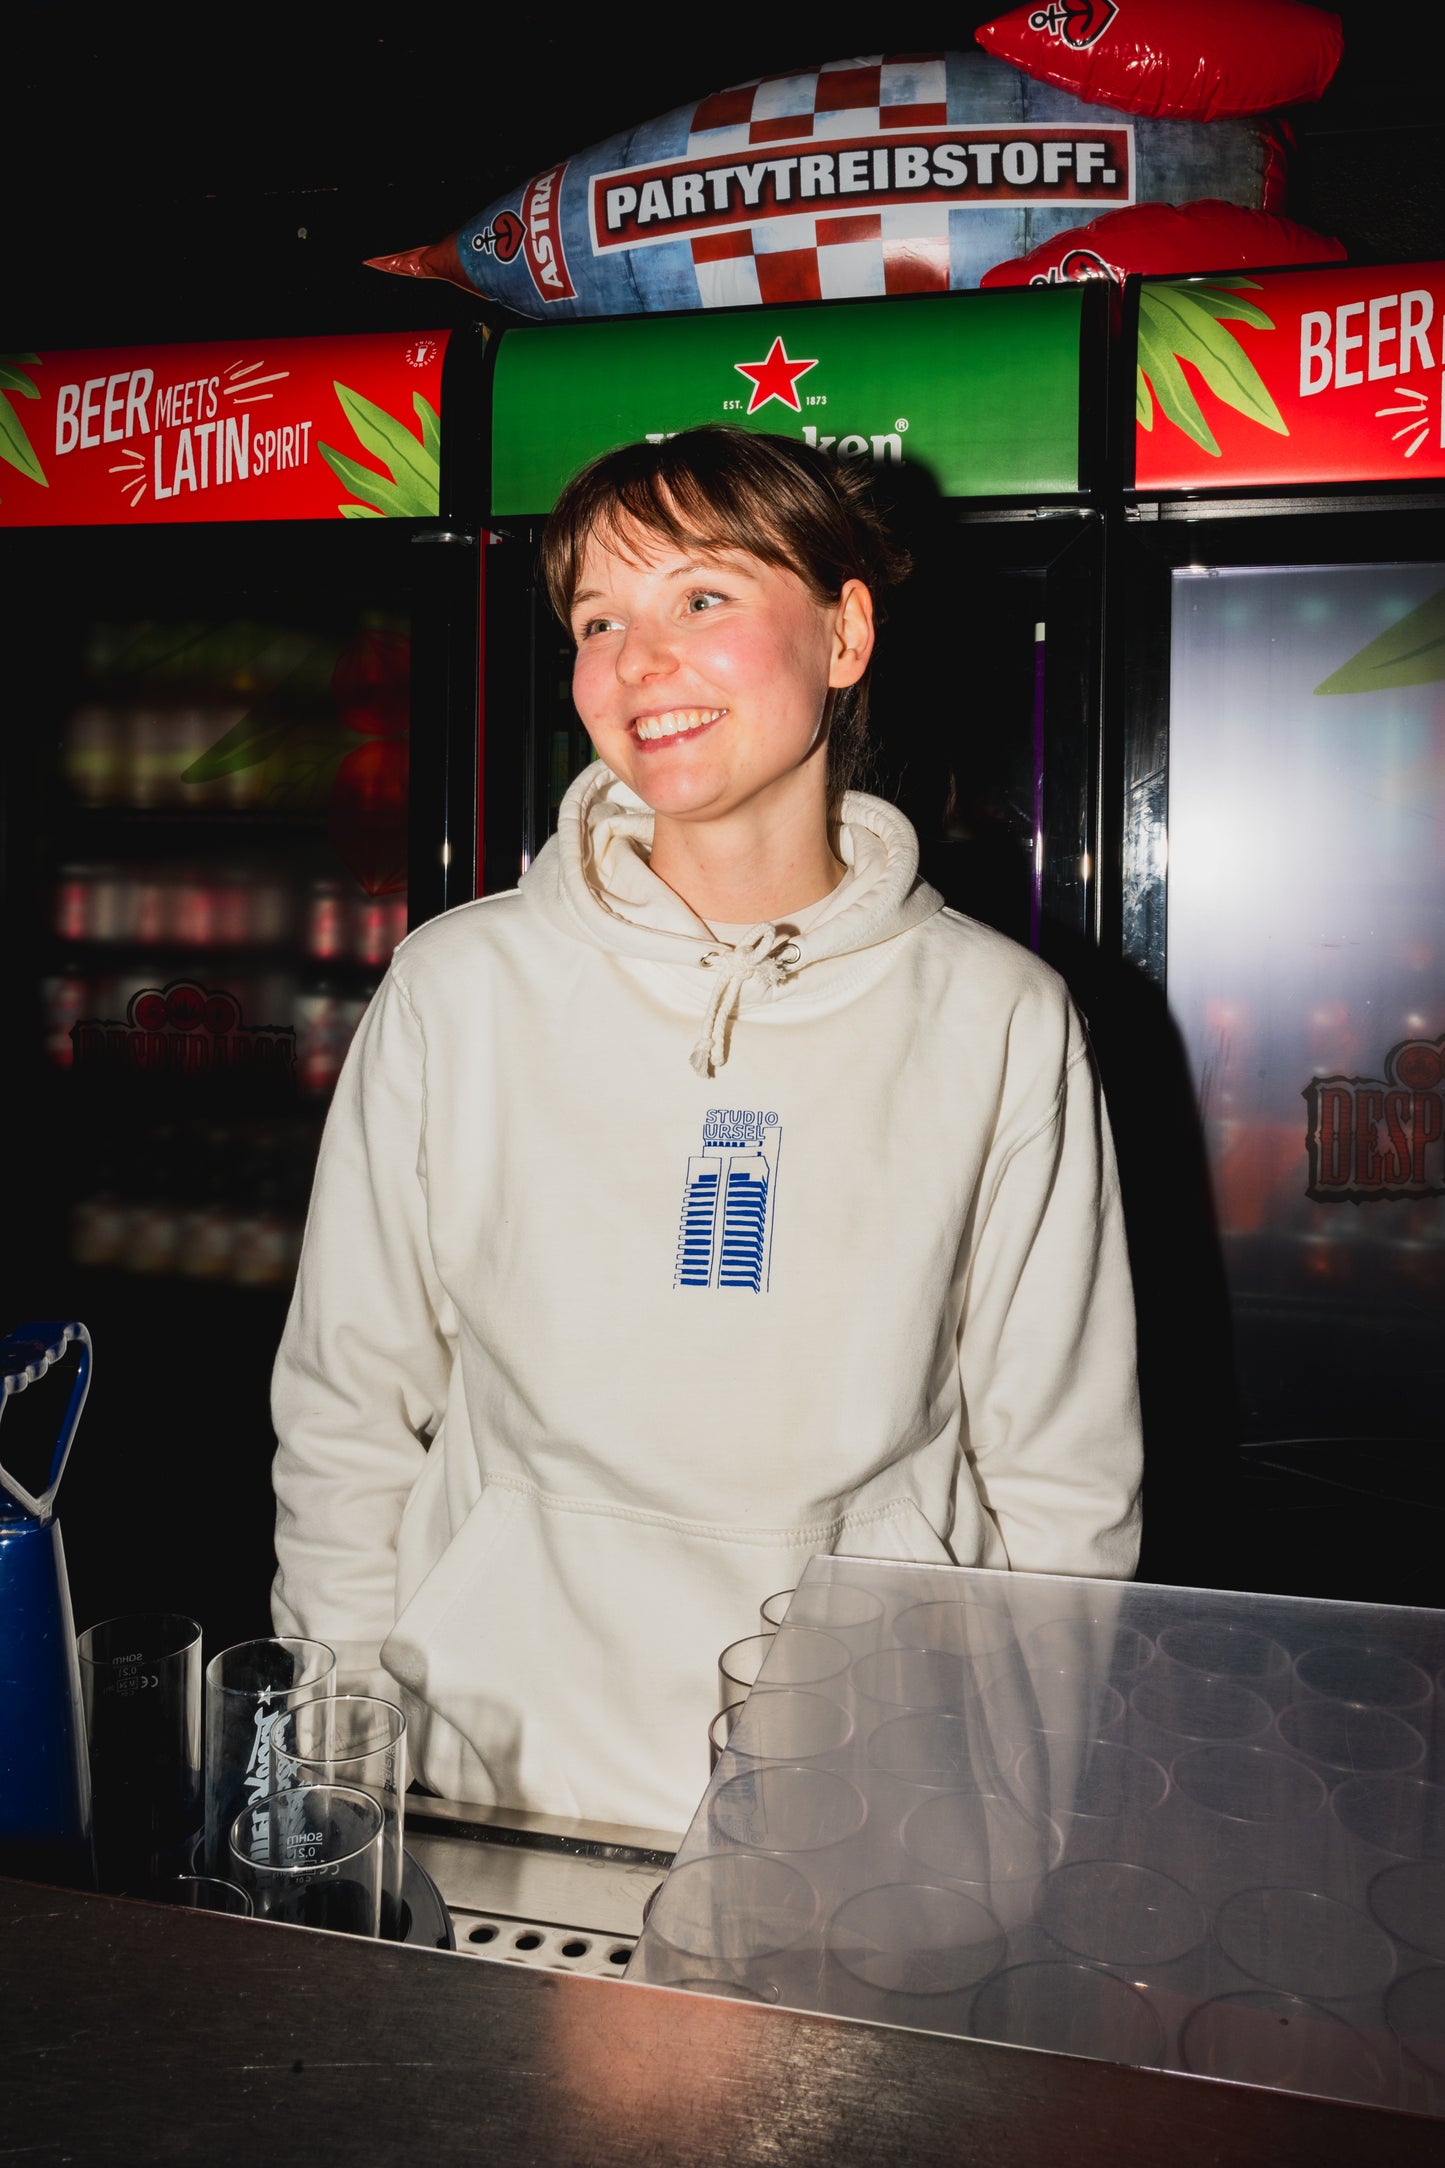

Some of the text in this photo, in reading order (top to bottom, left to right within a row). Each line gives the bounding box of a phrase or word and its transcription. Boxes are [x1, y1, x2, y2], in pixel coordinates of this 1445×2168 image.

[530, 171, 564, 288] ASTRA
[606, 141, 1116, 230] PARTYTREIBSTOFF.
[1299, 289, 1436, 398] BEER
[55, 368, 220, 455] BEER MEETS
[723, 395, 828, 410] EST. 1873
[154, 413, 313, 501] LATIN SPIRIT
[704, 1123, 766, 1140] URSEL
[705, 1108, 779, 1126] STUDIO
[1318, 1087, 1445, 1186] DESP
